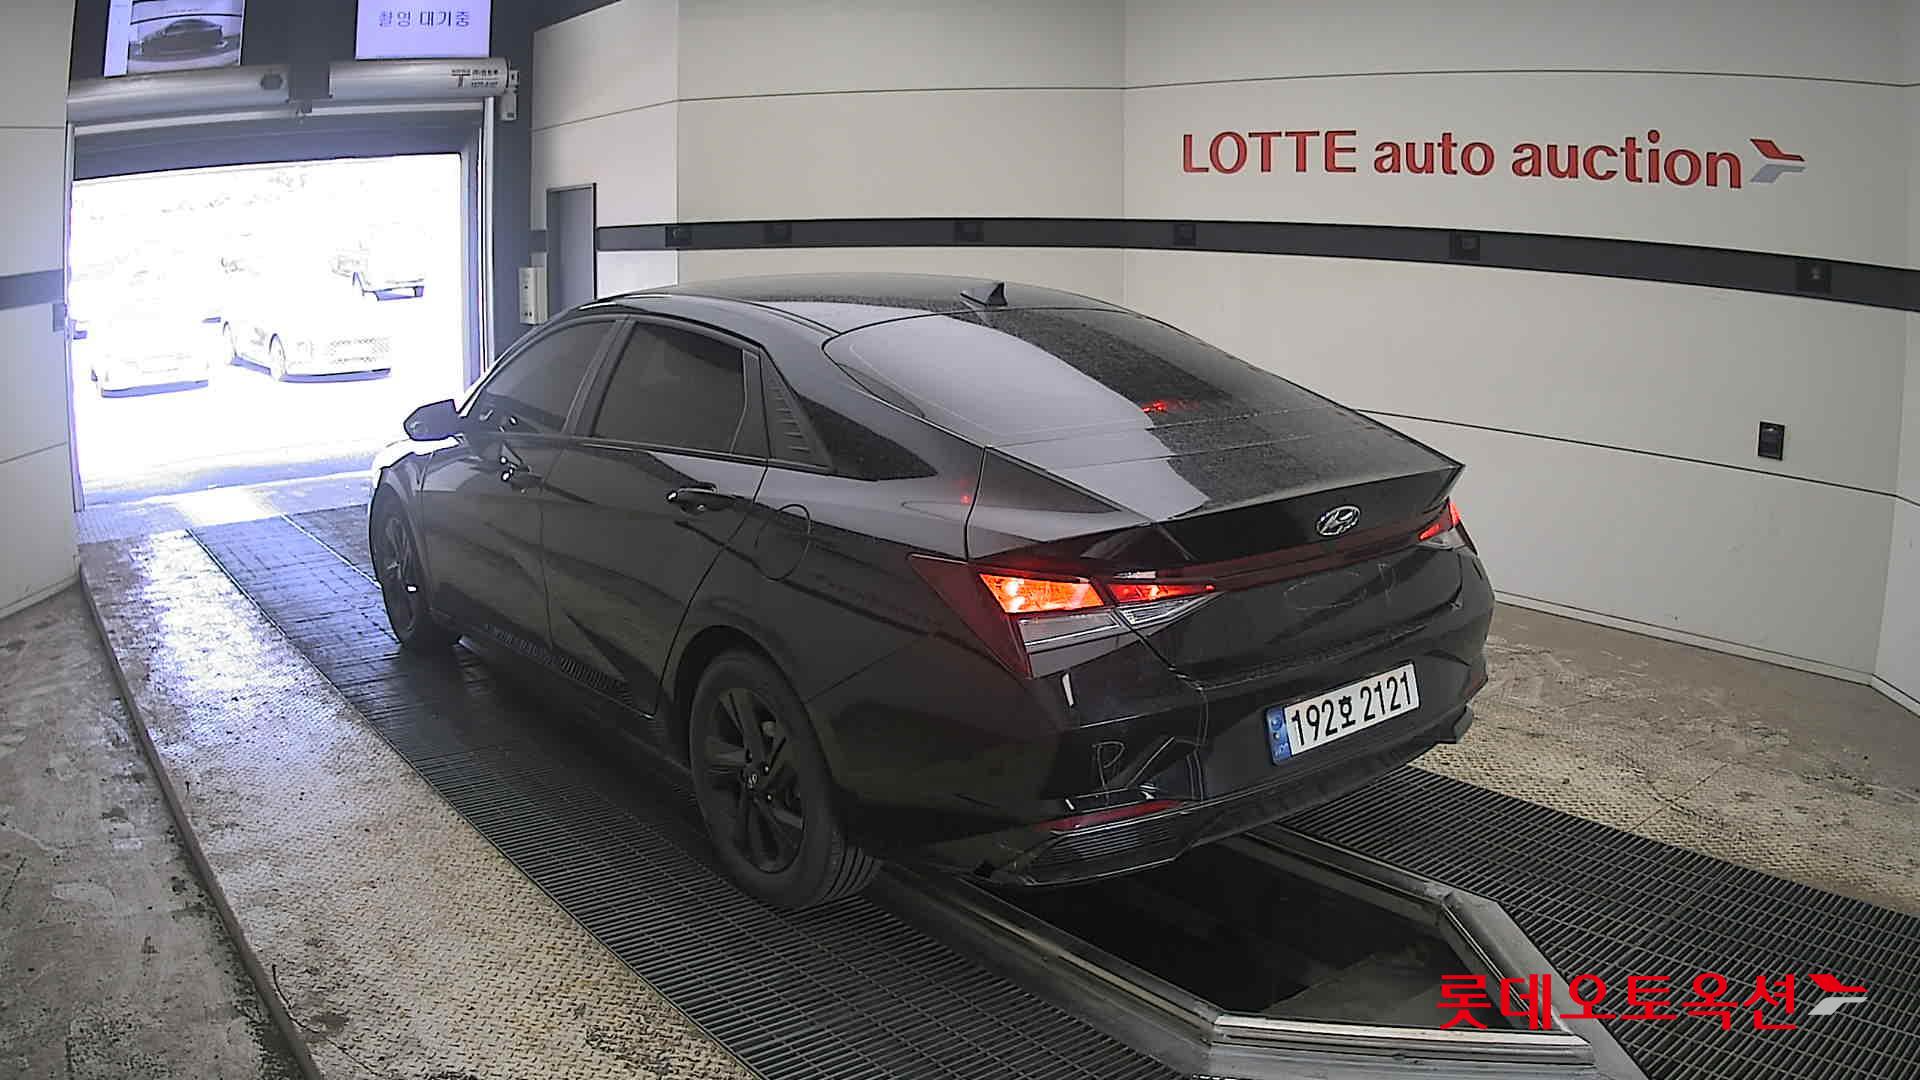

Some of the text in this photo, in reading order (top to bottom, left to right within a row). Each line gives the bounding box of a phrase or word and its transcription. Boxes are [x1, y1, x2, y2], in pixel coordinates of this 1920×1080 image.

[420, 10, 470, 28] 대기중
[1183, 130, 1742, 189] LOTTE auto auction
[1291, 671, 1411, 746] 192호 2121
